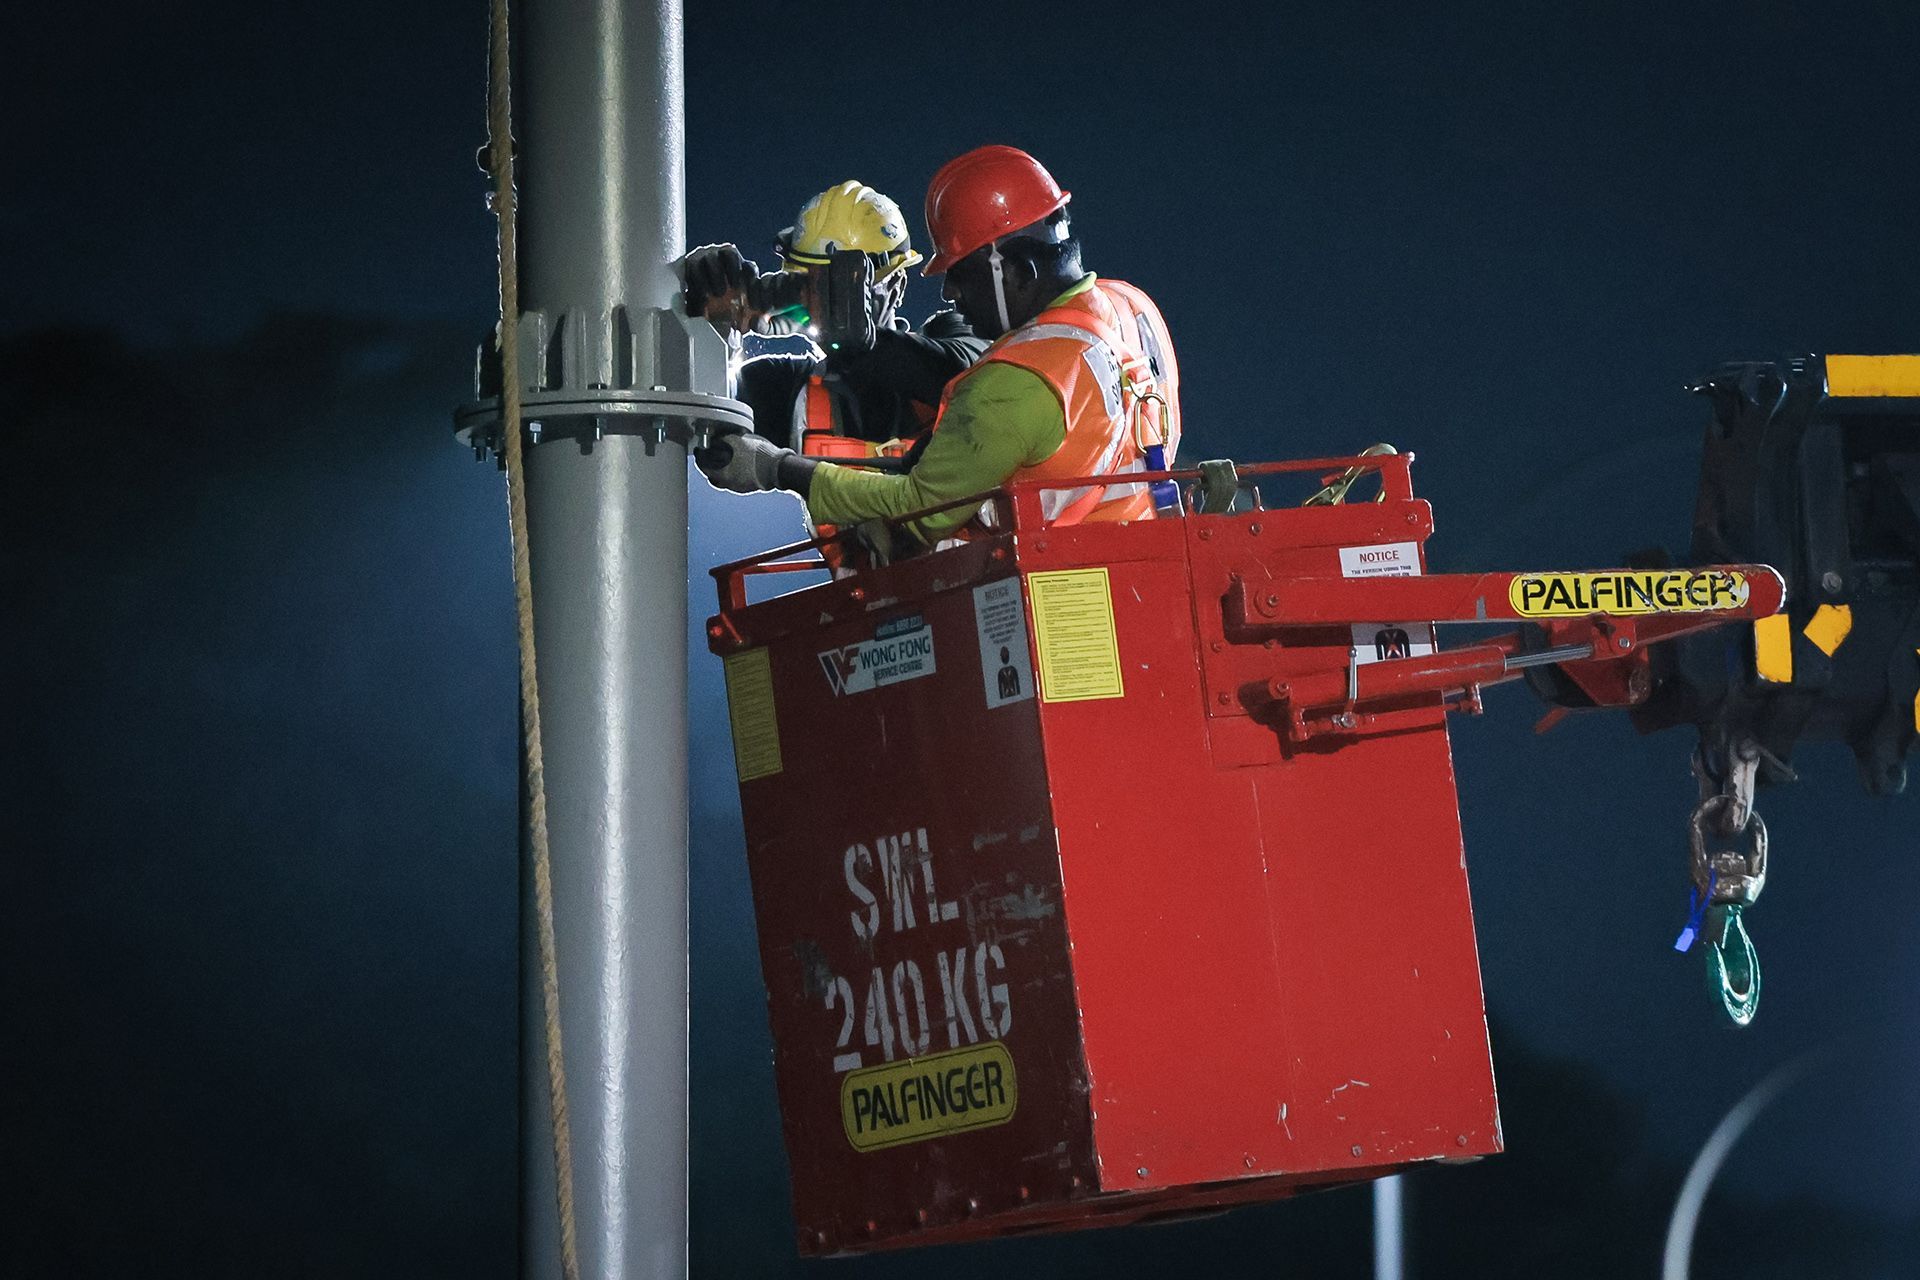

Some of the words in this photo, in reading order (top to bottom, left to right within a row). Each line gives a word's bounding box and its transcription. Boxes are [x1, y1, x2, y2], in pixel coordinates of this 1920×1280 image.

[1359, 550, 1399, 563] NOTICE
[1521, 574, 1738, 611] PALFINGER
[860, 644, 897, 670] WONG
[899, 635, 931, 659] FONG
[844, 828, 960, 941] SWL
[824, 960, 931, 1073] 240
[937, 942, 1012, 1049] KG
[852, 1060, 1006, 1134] PALFINGER
